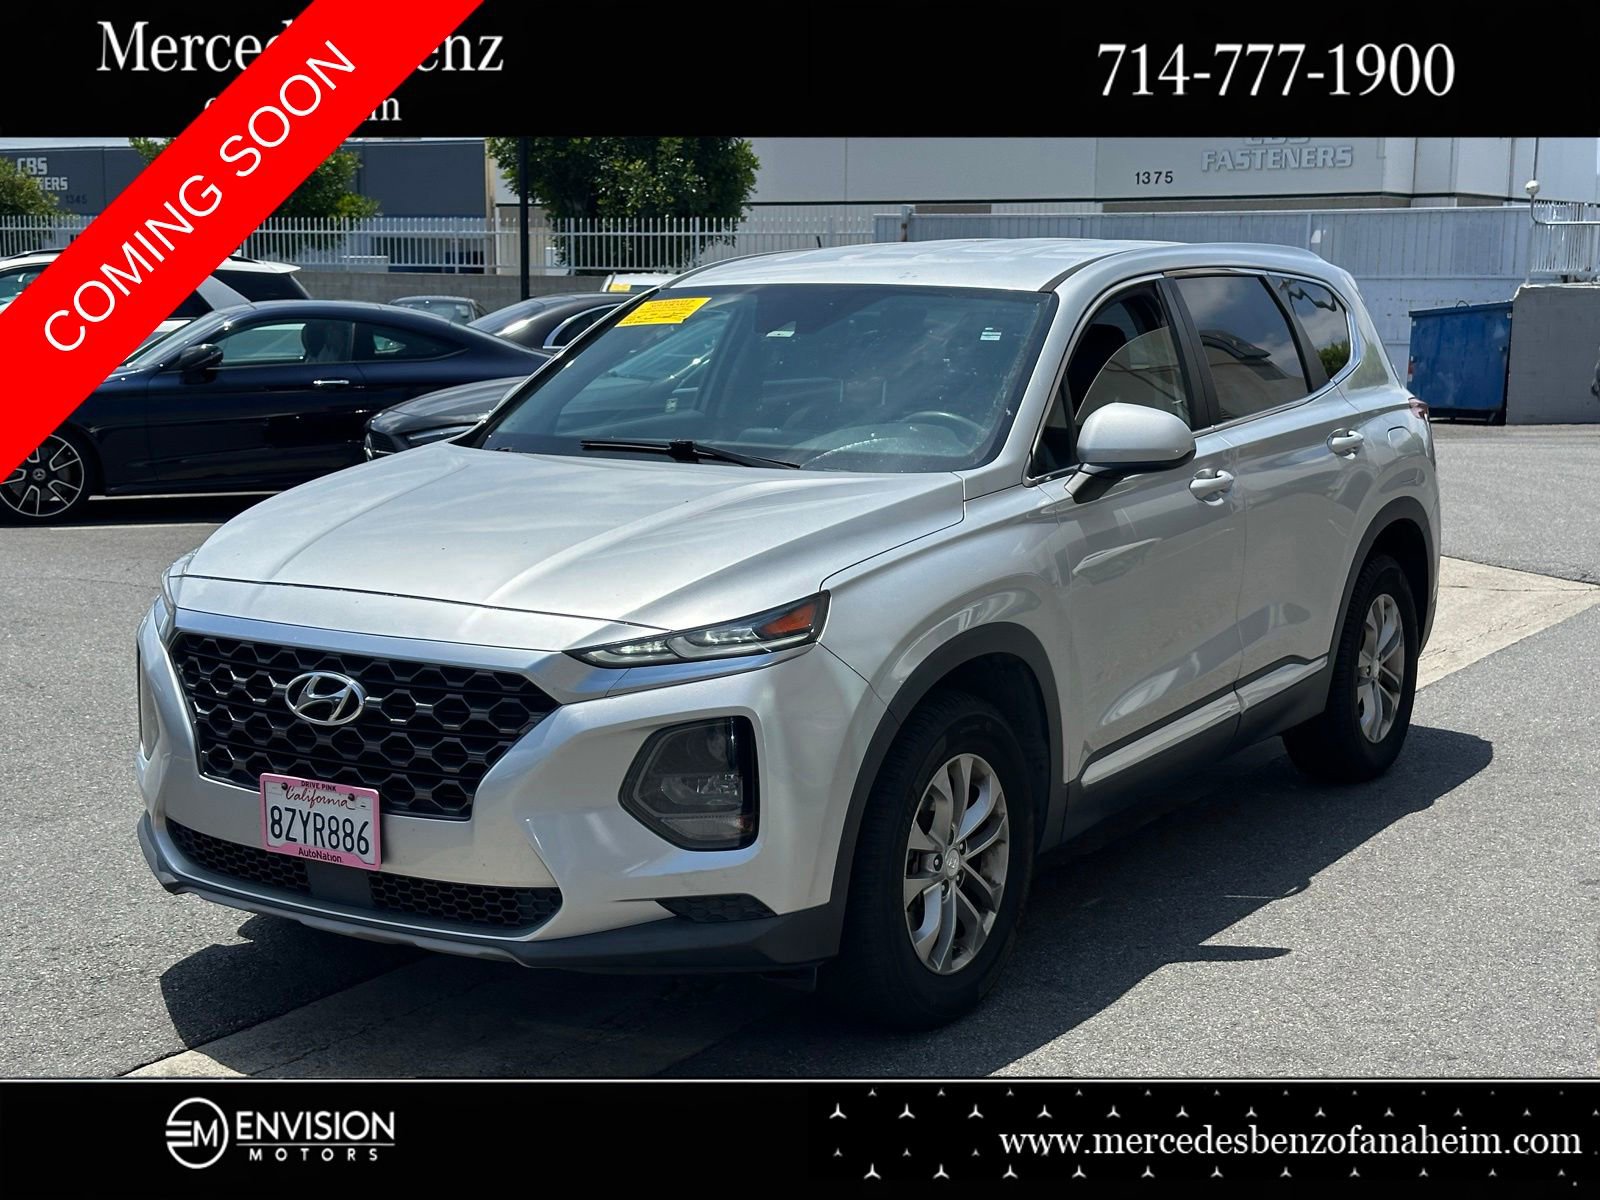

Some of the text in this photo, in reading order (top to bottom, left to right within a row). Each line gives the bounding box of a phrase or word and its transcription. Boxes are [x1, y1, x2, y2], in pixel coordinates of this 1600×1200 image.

[1201, 146, 1354, 172] FASTENERS
[1135, 170, 1174, 185] 1375
[301, 780, 337, 792] DRIVE PINK
[285, 785, 356, 810] California
[270, 805, 370, 855] 8ZYR886
[298, 847, 342, 863] AutoNation
